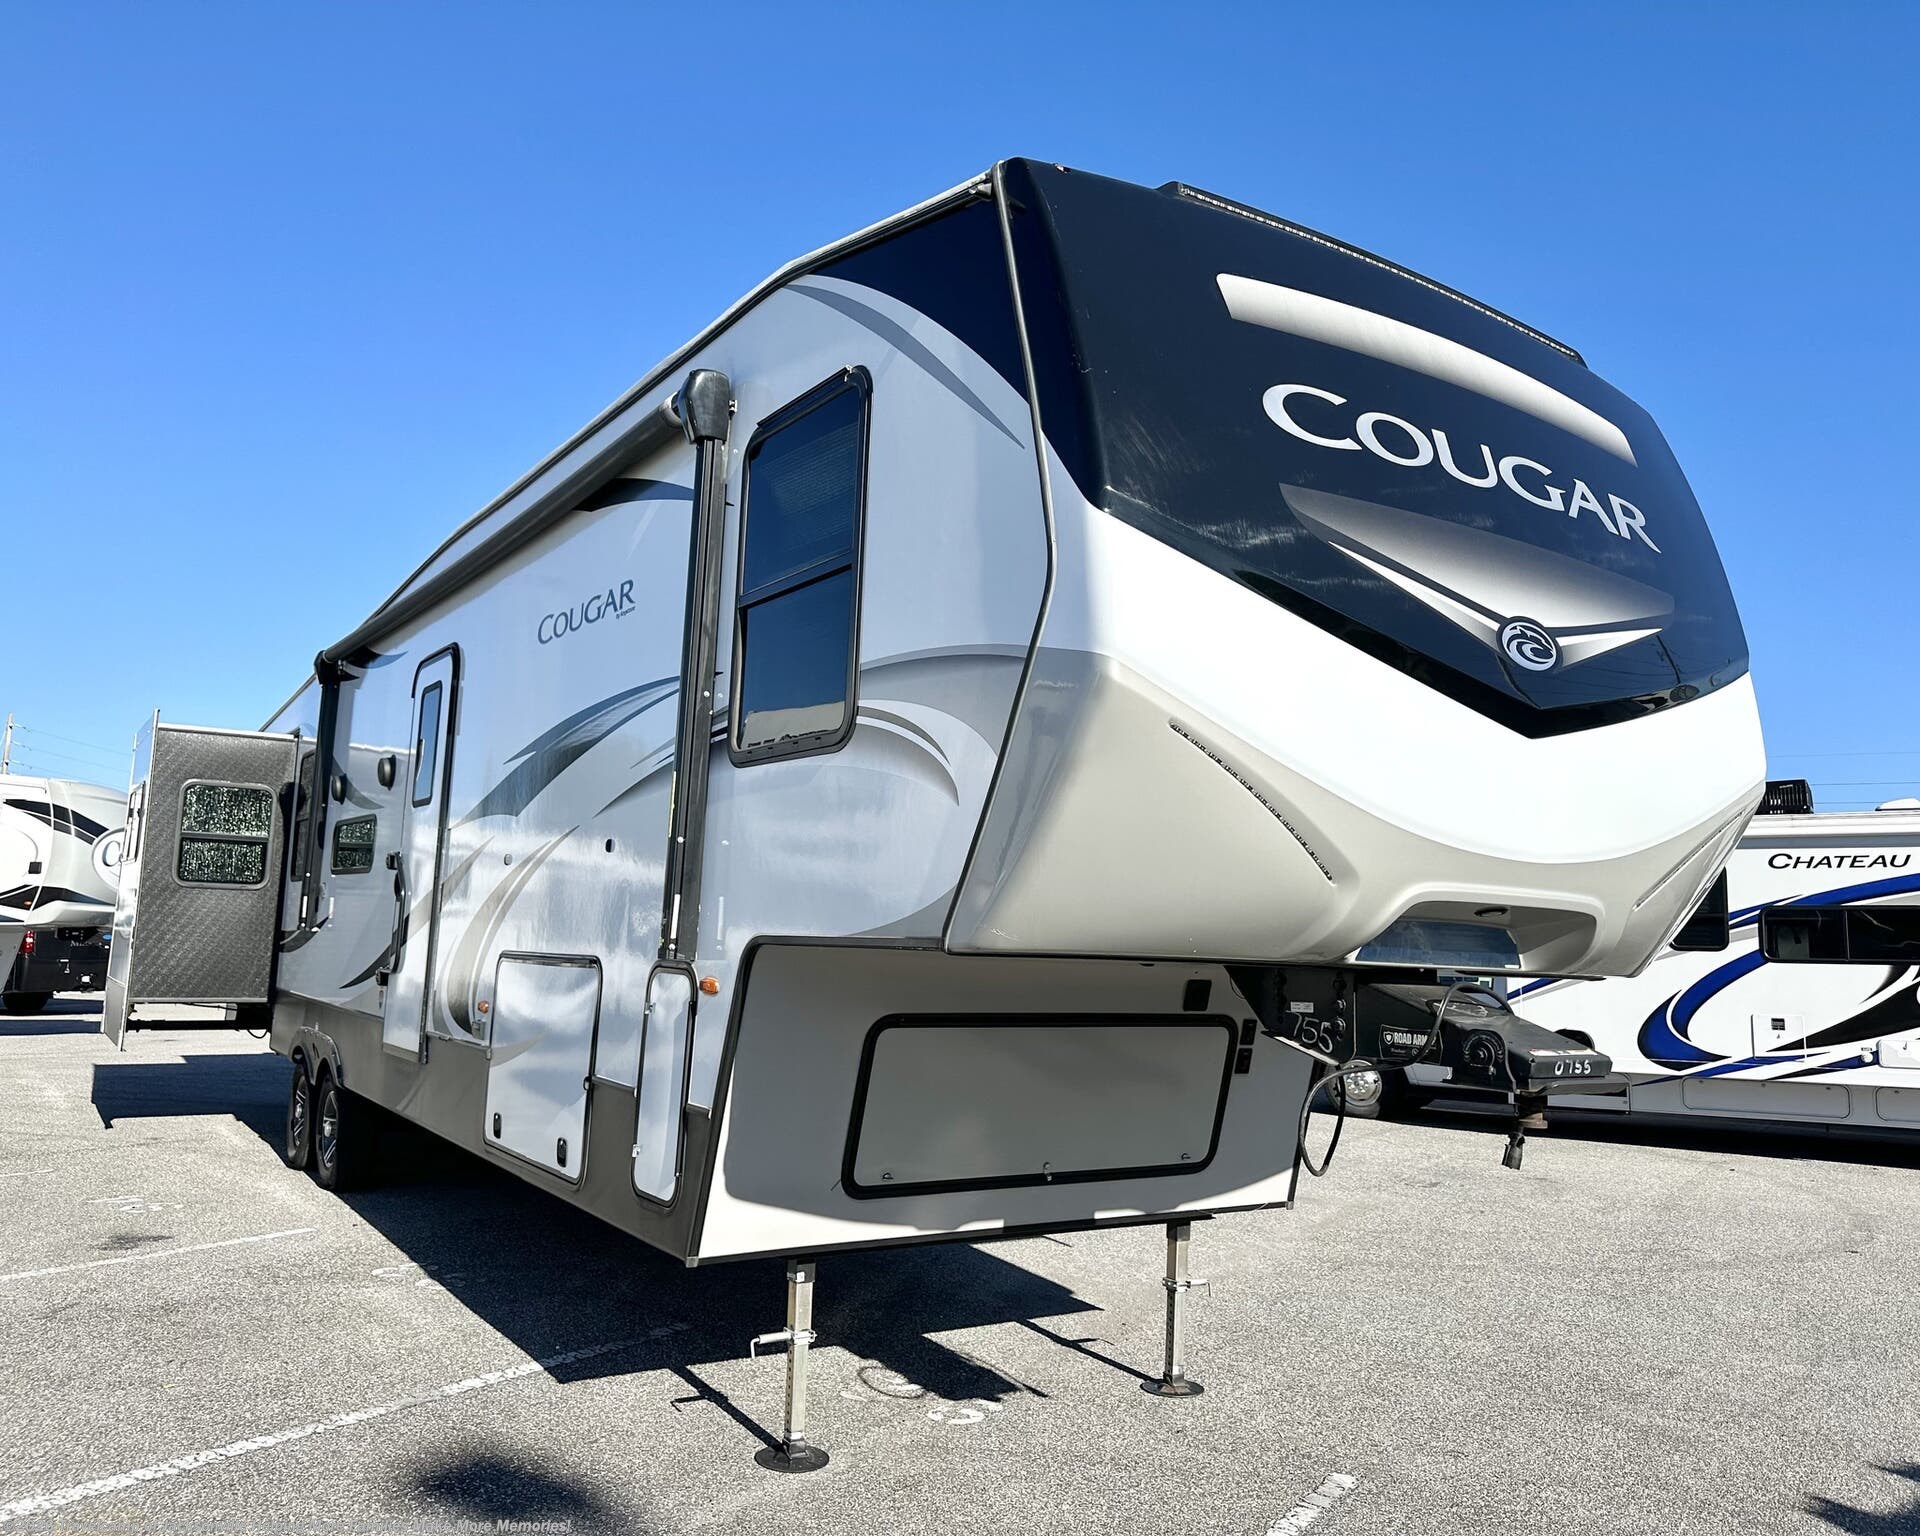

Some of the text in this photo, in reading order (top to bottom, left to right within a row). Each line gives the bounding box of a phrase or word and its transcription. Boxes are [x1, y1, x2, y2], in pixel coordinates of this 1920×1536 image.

[1262, 383, 1661, 554] COUGAR
[537, 579, 635, 645] COUGAR
[1767, 853, 1912, 869] CHATEAU
[1285, 1010, 1333, 1053] 755
[1394, 1032, 1437, 1047] ROAD ARM
[1554, 1059, 1592, 1075] 0755
